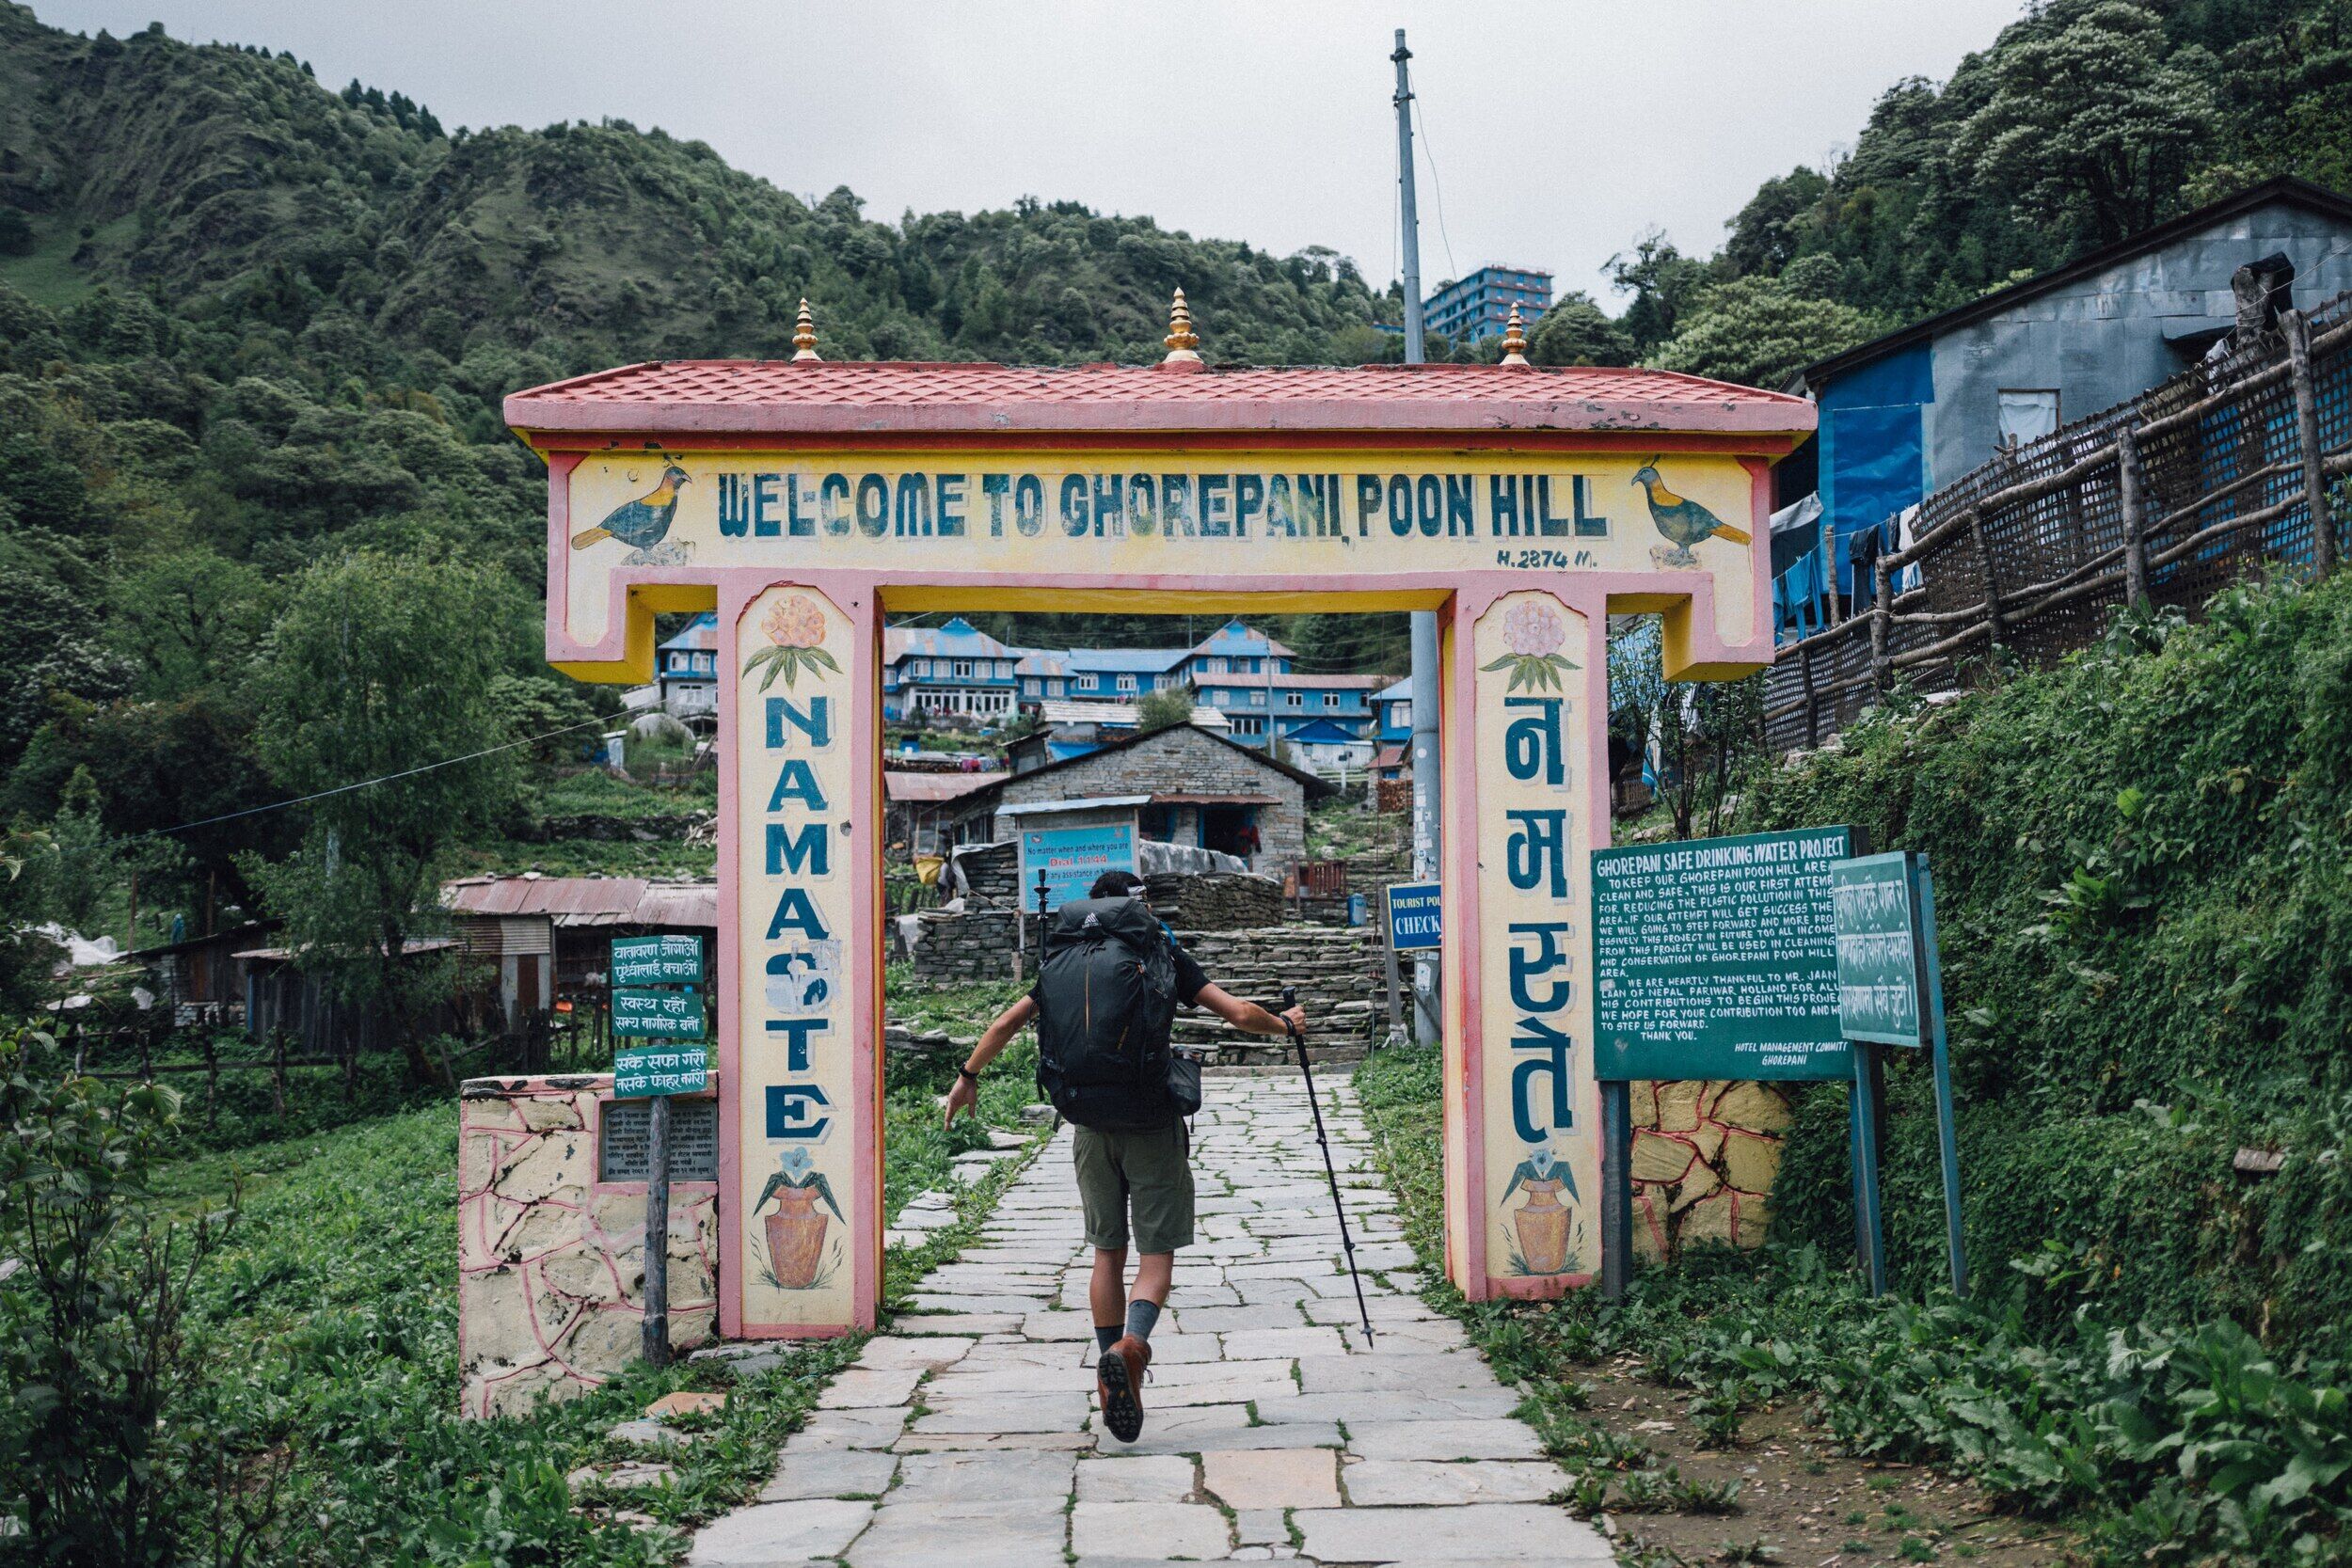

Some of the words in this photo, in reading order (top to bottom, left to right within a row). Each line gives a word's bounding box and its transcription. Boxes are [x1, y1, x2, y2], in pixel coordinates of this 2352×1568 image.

[981, 473, 1043, 539] TO
[1356, 473, 1473, 538] POON
[1490, 473, 1608, 537] HILL
[1497, 549, 1568, 568] H.2874
[1089, 843, 1104, 851] where
[1106, 843, 1117, 852] you
[1050, 857, 1073, 866] Dial
[1078, 854, 1107, 865] 1144
[1597, 854, 1661, 877] GHOREPANI
[1664, 851, 1693, 871] SAFE
[1695, 846, 1752, 868] DRINKING
[1755, 841, 1798, 863] WATER
[1800, 836, 1844, 859] PROJECT
[1062, 868, 1092, 879] assistance
[1609, 879, 1621, 889] TO
[1623, 877, 1651, 888] KEEP
[1655, 875, 1676, 884] OUR
[1680, 868, 1741, 883] GHOREPANI
[1745, 865, 1773, 878] POON
[1776, 863, 1800, 875] HILL
[1599, 892, 1631, 902] CLEAN
[1635, 890, 1654, 899] AND
[1692, 884, 1716, 895] THIS
[1720, 882, 1730, 893] IS
[1735, 882, 1758, 892] OUR
[1761, 879, 1790, 890] FIRST
[1392, 896, 1424, 909] TOURIST
[1599, 905, 1619, 914] FOR
[1624, 900, 1674, 913] REDUCING
[1678, 898, 1695, 909] THE
[1701, 895, 1736, 908] PLASTIC
[1740, 890, 1791, 903] POLLUTION
[1794, 890, 1804, 900] IN
[1808, 888, 1834, 898] THIS
[764, 696, 830, 1139] NAMASTE
[1503, 696, 1573, 1144] नमस्ते
[1630, 914, 1639, 924] IF
[1645, 913, 1664, 923] OUR
[1667, 911, 1708, 922] ATTEMPT
[1712, 908, 1733, 919] WILL
[1738, 907, 1758, 917] GET
[1763, 903, 1807, 916] SUCCESS
[1811, 901, 1833, 911] THE
[1395, 914, 1441, 935] CHECK
[1618, 926, 1636, 935] WILL
[1641, 925, 1668, 934] GOING
[1686, 922, 1709, 931] STEP
[1712, 918, 1756, 930] FORWARD
[1760, 916, 1780, 927] AND
[1783, 915, 1809, 926] MORE
[1599, 937, 1639, 945] ESSIVELY
[1643, 935, 1661, 943] THIS
[1663, 933, 1702, 943] PROJECT
[1707, 932, 1715, 941] IN
[1720, 929, 1753, 940] FUTURE
[1798, 924, 1836, 935] INCOME
[614, 943, 659, 959] वातावरण
[1599, 946, 1626, 956] FROM
[1629, 946, 1650, 955] THIS
[1654, 943, 1693, 955] PROJECT
[1698, 942, 1718, 951] WILL
[1722, 942, 1735, 950] BE
[1740, 941, 1767, 949] USED
[1771, 939, 1782, 948] IN
[1785, 937, 1836, 947] CLEANING
[1599, 958, 1616, 967] AND
[1622, 955, 1692, 967] CONSERVATION
[1712, 952, 1769, 961] GHOREPANI
[1774, 950, 1804, 960] POON
[1808, 948, 1834, 958] HILL
[1599, 969, 1629, 977] AREA.
[1628, 979, 1642, 988] WE
[1645, 978, 1664, 988] ARE
[1668, 976, 1709, 986] HEARTLY
[1712, 974, 1765, 984] THANKFUL
[1786, 973, 1804, 982] MR.
[1807, 971, 1836, 980] JAAN
[1601, 990, 1626, 998] LAAN
[1630, 989, 1645, 997] OF
[1648, 988, 1683, 996] NEPAL
[1690, 986, 1737, 995] PARIWAR
[1740, 984, 1788, 994] HOLLAND
[1791, 983, 1814, 993] FOR
[1820, 982, 1840, 991] ALL
[621, 997, 659, 1011] स्वस्थ
[1601, 1000, 1618, 1008] HIS
[1625, 997, 1711, 1008] CONTRIBUTIONS
[1717, 996, 1733, 1005] TO
[1739, 995, 1772, 1005] BEGIN
[1776, 994, 1800, 1004] THIS
[1601, 1010, 1617, 1020] WE
[1622, 1010, 1649, 1020] HOPE
[1654, 1009, 1677, 1020] FOR
[1680, 1008, 1707, 1018] YOUR
[1710, 1006, 1782, 1018] CONTRIBUTION
[1786, 1006, 1806, 1016] TOO
[1811, 1006, 1829, 1016] AND
[642, 1014, 676, 1031] नागरिक
[1601, 1022, 1613, 1031] TO
[1616, 1022, 1640, 1031] STEP
[1660, 1020, 1708, 1029] FORWARD.
[1641, 1032, 1671, 1040] THANK
[1675, 1031, 1697, 1040] YOU.
[1735, 1043, 1756, 1052] HOTEL
[1759, 1042, 1814, 1053] MANAGEMENT
[616, 1053, 646, 1071] सके
[647, 1053, 680, 1069] सफा
[1762, 1055, 1807, 1066] GHOREPANI
[616, 1072, 648, 1092] नसके
